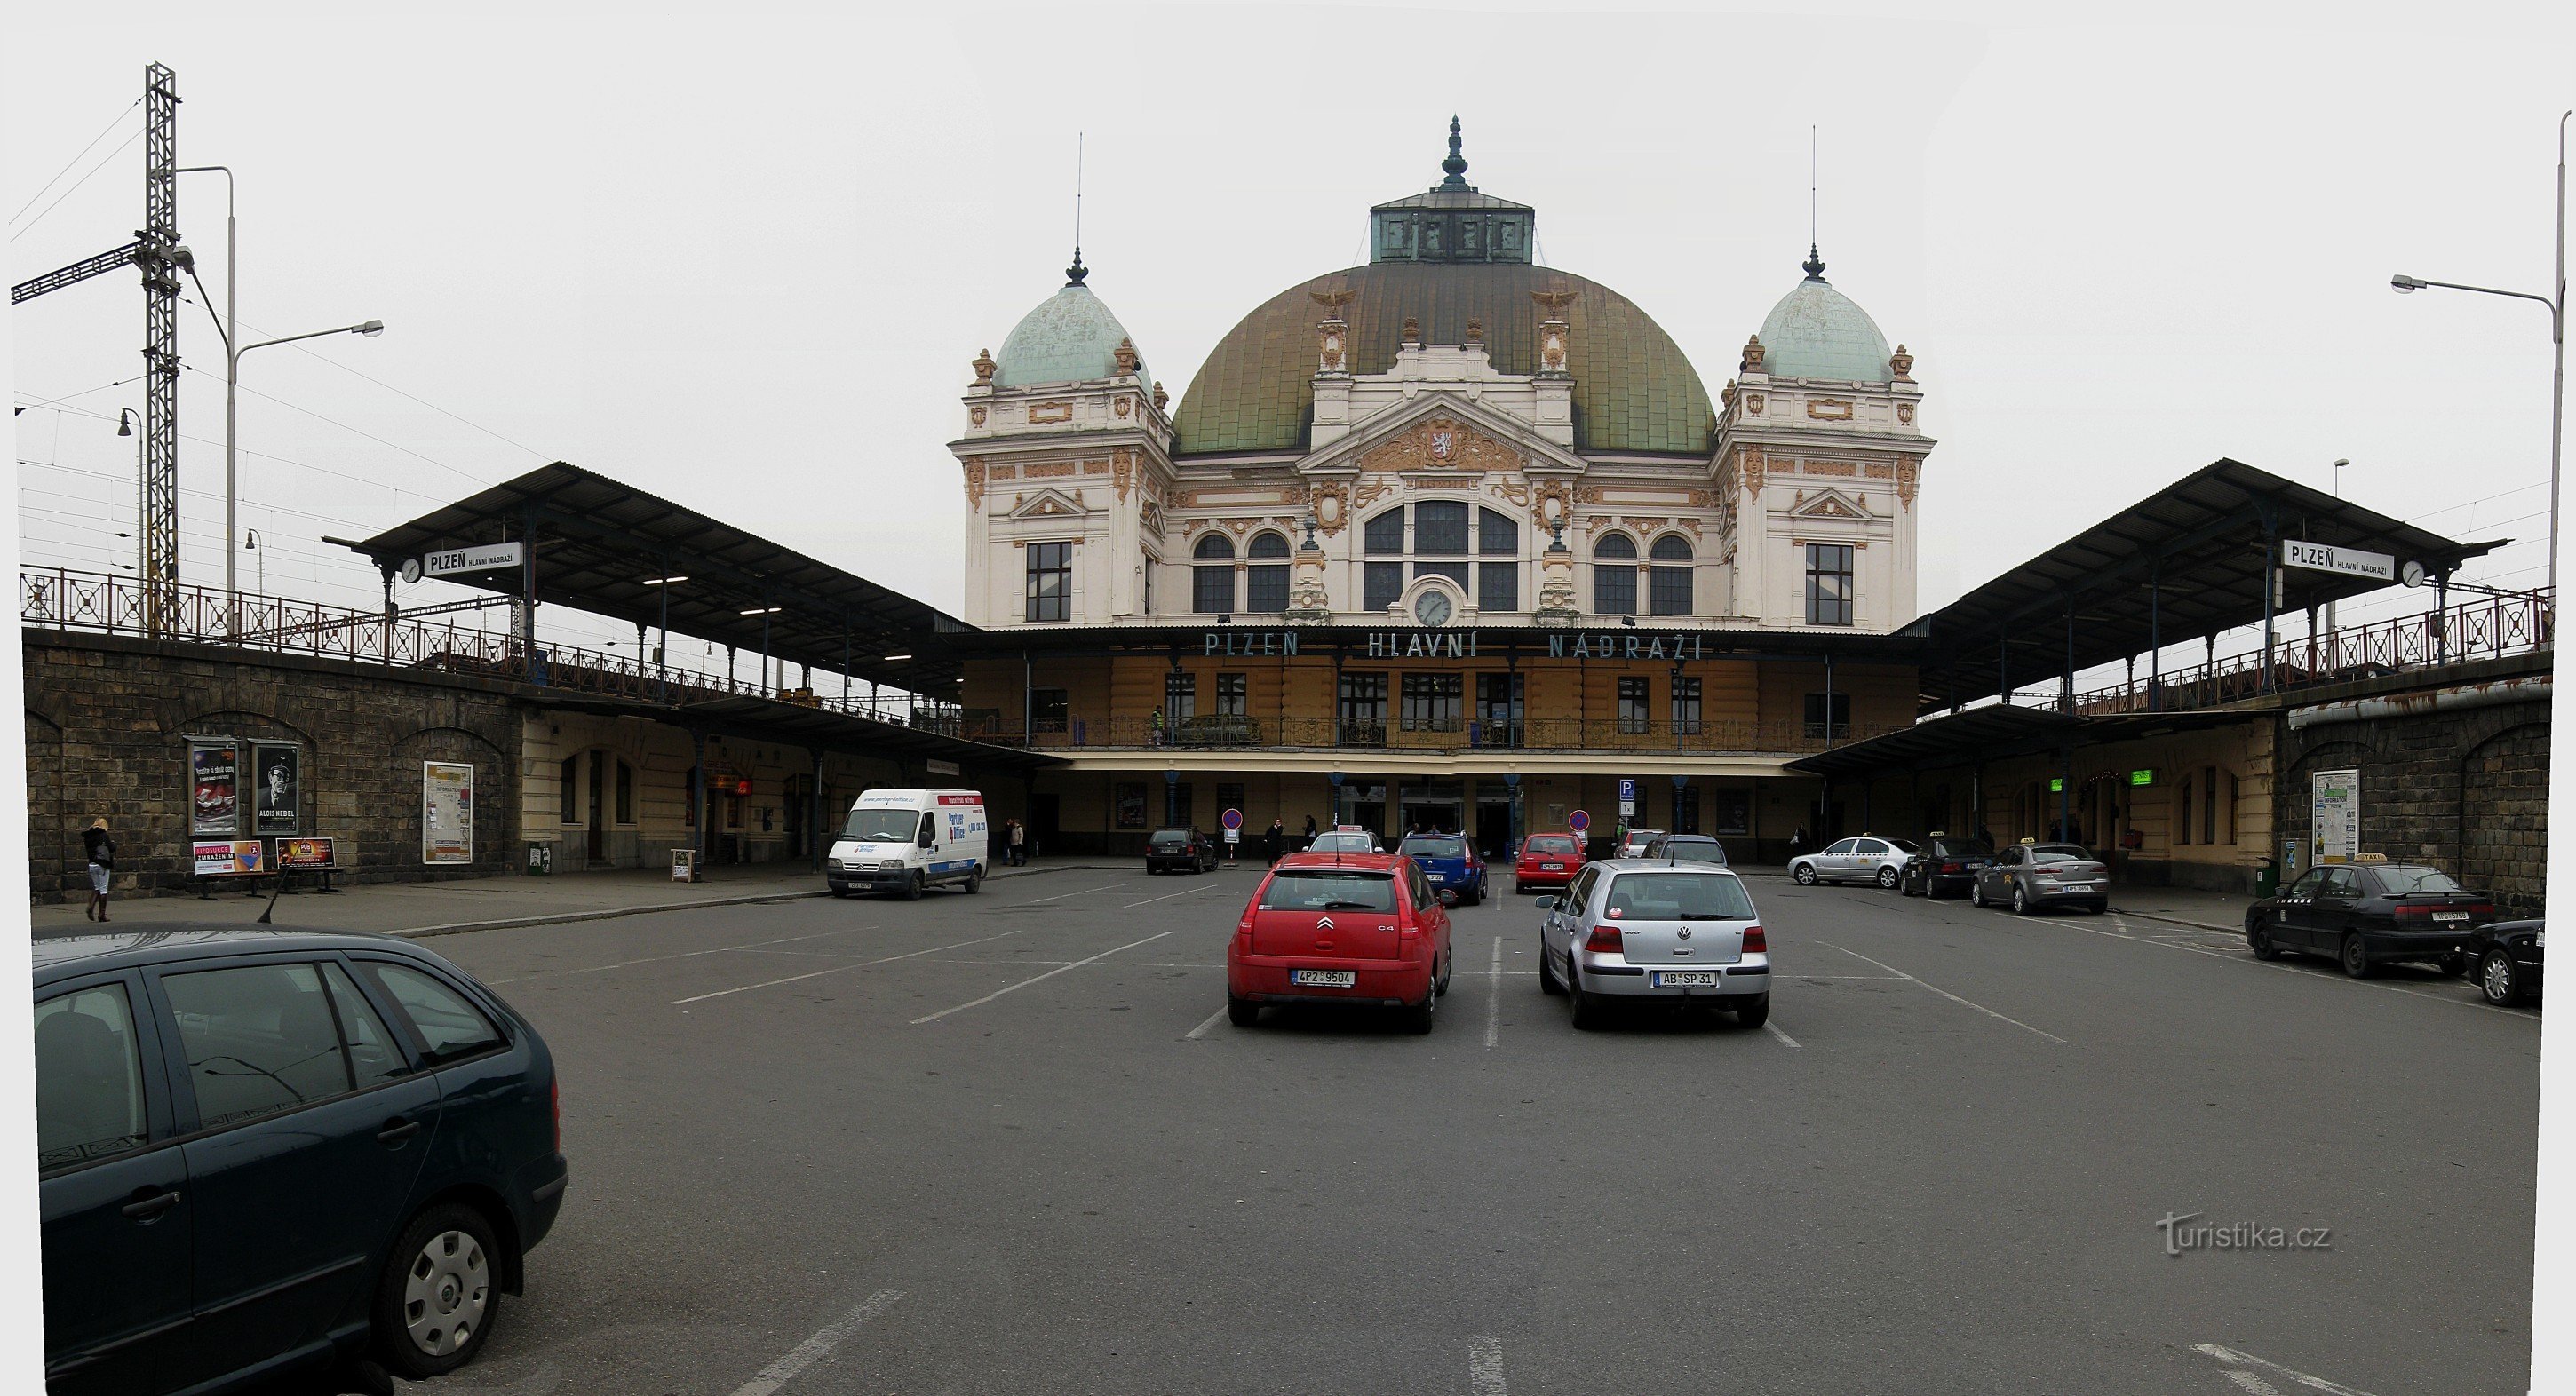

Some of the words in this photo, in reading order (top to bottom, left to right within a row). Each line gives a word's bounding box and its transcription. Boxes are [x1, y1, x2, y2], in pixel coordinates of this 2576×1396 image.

[431, 551, 465, 571] PLZEŇ
[468, 556, 488, 567] HLAVNÍ
[489, 554, 513, 564] NÁDRAŽÍ
[2292, 545, 2334, 567] PLZEŇ
[2337, 560, 2359, 571] HLAVNÍ
[2361, 563, 2387, 575] NÁDRAŽÍ
[1205, 630, 1298, 656] PLZEŇ
[1368, 630, 1478, 658] HLAVNÍ
[1549, 632, 1701, 661] NÁDRAŽÍ
[1623, 781, 1632, 794] P
[948, 812, 964, 825] Partner
[197, 853, 234, 861] ZMRAŽENÍM
[1300, 972, 1318, 982] 4P2
[1325, 972, 1350, 983] 9504
[1664, 973, 1677, 984] AB
[1683, 973, 1697, 984] SP
[1699, 973, 1712, 984] 31
